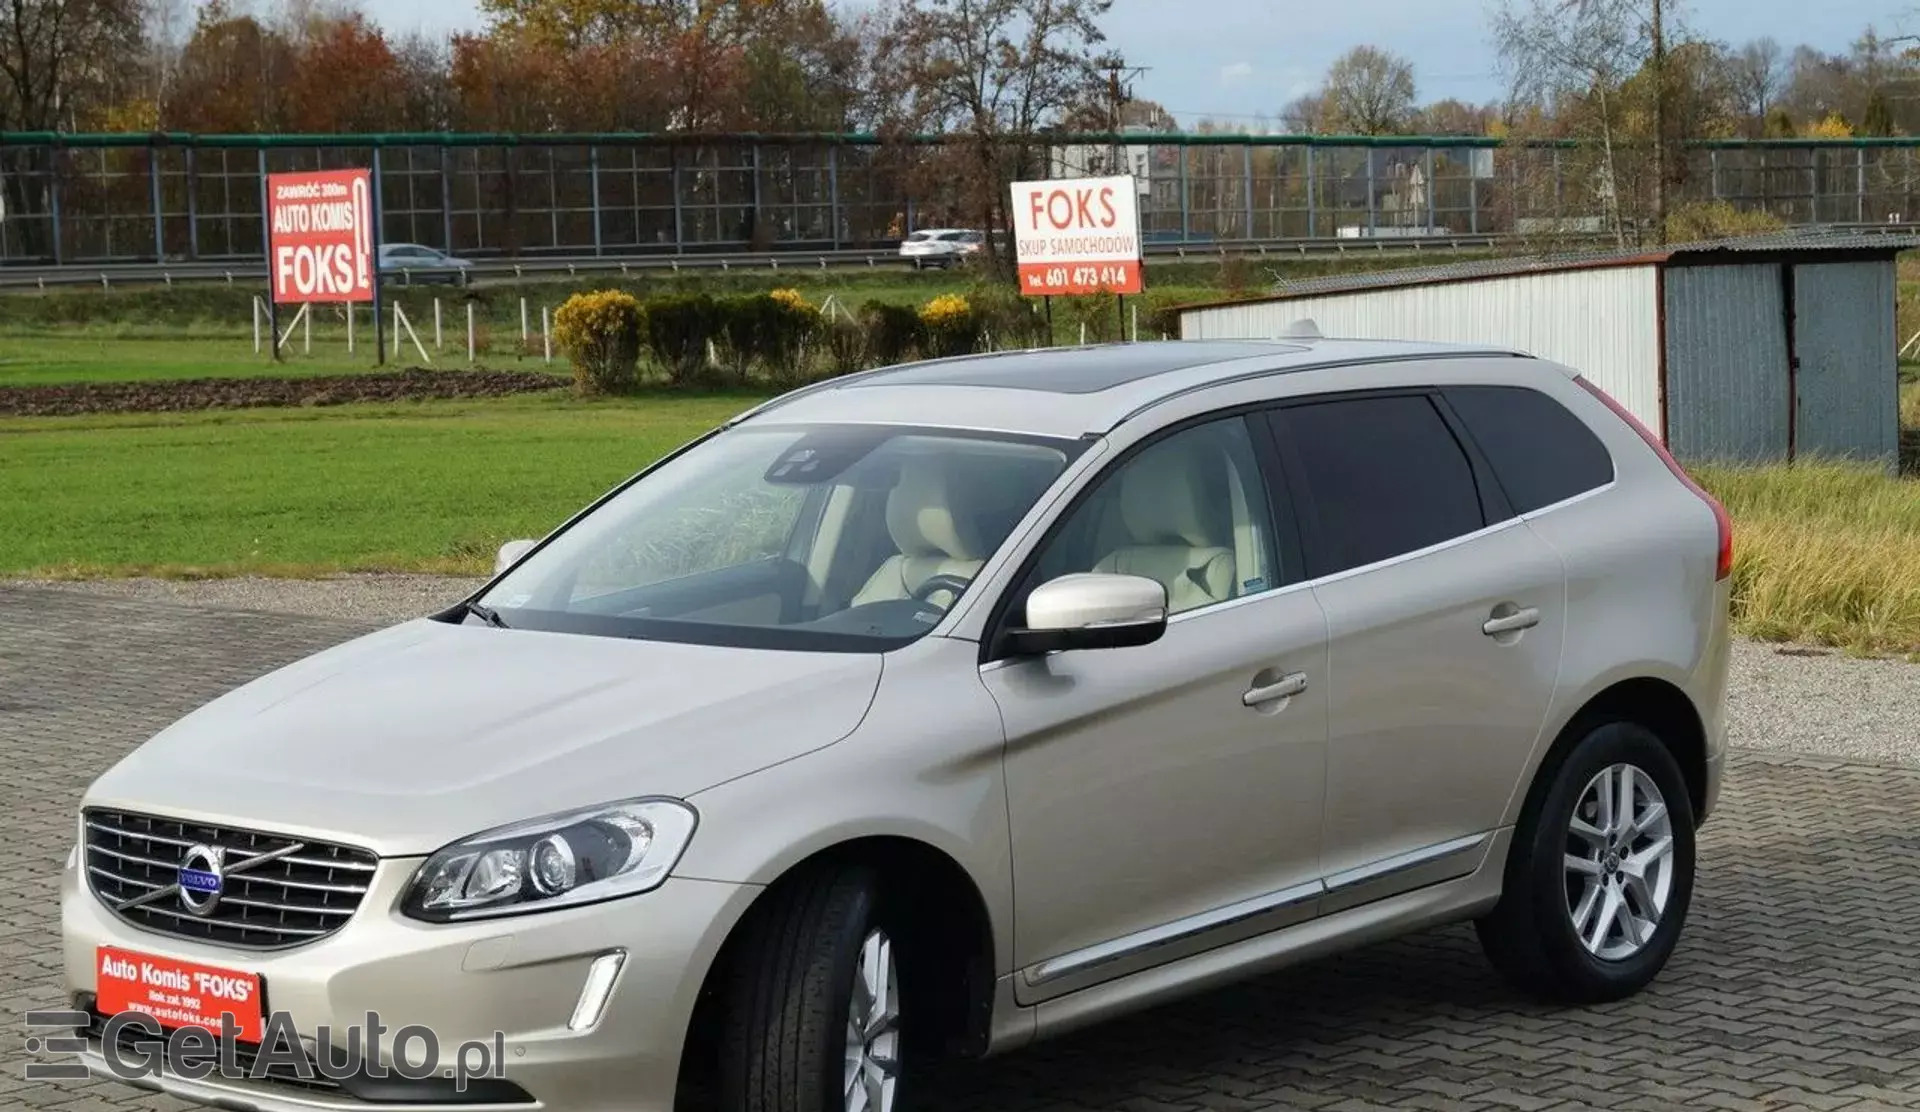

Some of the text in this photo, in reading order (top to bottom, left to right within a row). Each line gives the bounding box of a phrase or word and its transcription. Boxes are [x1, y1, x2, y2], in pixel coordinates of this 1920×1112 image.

[274, 202, 353, 232] AUTO KOMIS
[1030, 187, 1116, 230] FOKS
[1019, 233, 1134, 257] SKUP SAMOCHODÓW
[278, 244, 353, 294] FOKS
[1045, 268, 1069, 286] 601
[1072, 267, 1098, 286] 473
[181, 873, 216, 886] VOLVO
[101, 954, 137, 981] Auto
[142, 961, 190, 991] Komis
[148, 990, 165, 1002] Rok
[182, 996, 201, 1009] 1992
